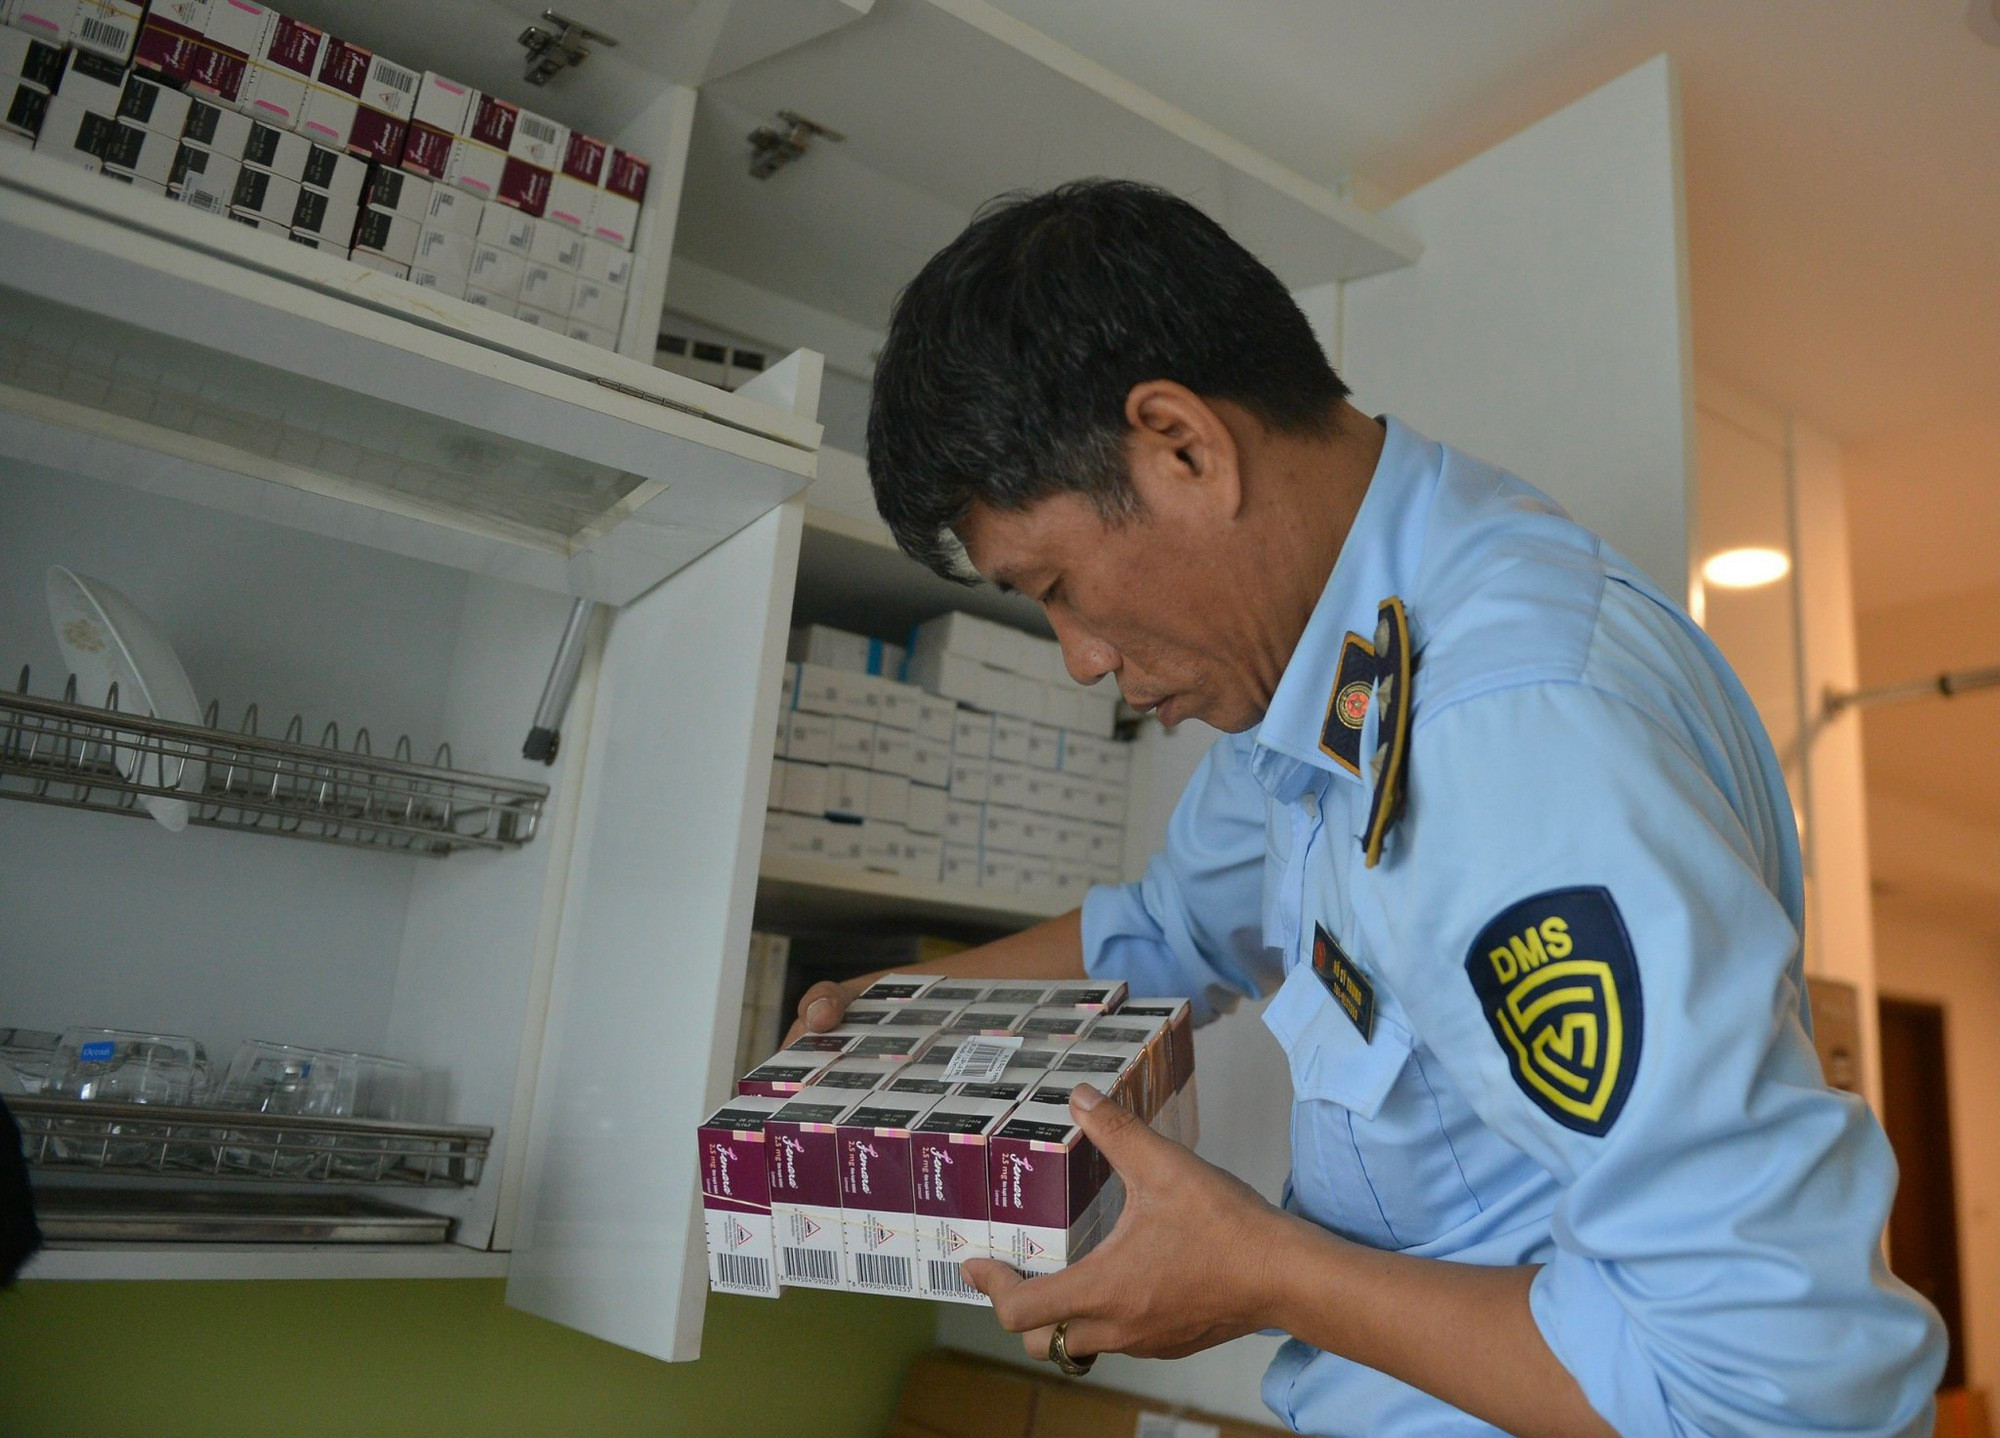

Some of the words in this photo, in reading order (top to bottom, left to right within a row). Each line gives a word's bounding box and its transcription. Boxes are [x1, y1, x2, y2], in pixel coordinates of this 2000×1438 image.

[1489, 916, 1573, 985] DMS
[774, 1135, 782, 1147] 2.5
[848, 1140, 856, 1152] 2.5
[774, 1148, 782, 1162] mg
[922, 1146, 930, 1158] 2.5
[1001, 1153, 1009, 1165] 2.5
[709, 1156, 717, 1169] mg
[782, 1135, 804, 1189] Femara
[848, 1154, 855, 1167] mg
[856, 1140, 879, 1194] Femara
[921, 1160, 929, 1173] mg
[716, 1143, 738, 1195] Femara
[930, 1146, 953, 1201] Femara
[1000, 1166, 1008, 1180] mg
[1009, 1153, 1034, 1209] Femara
